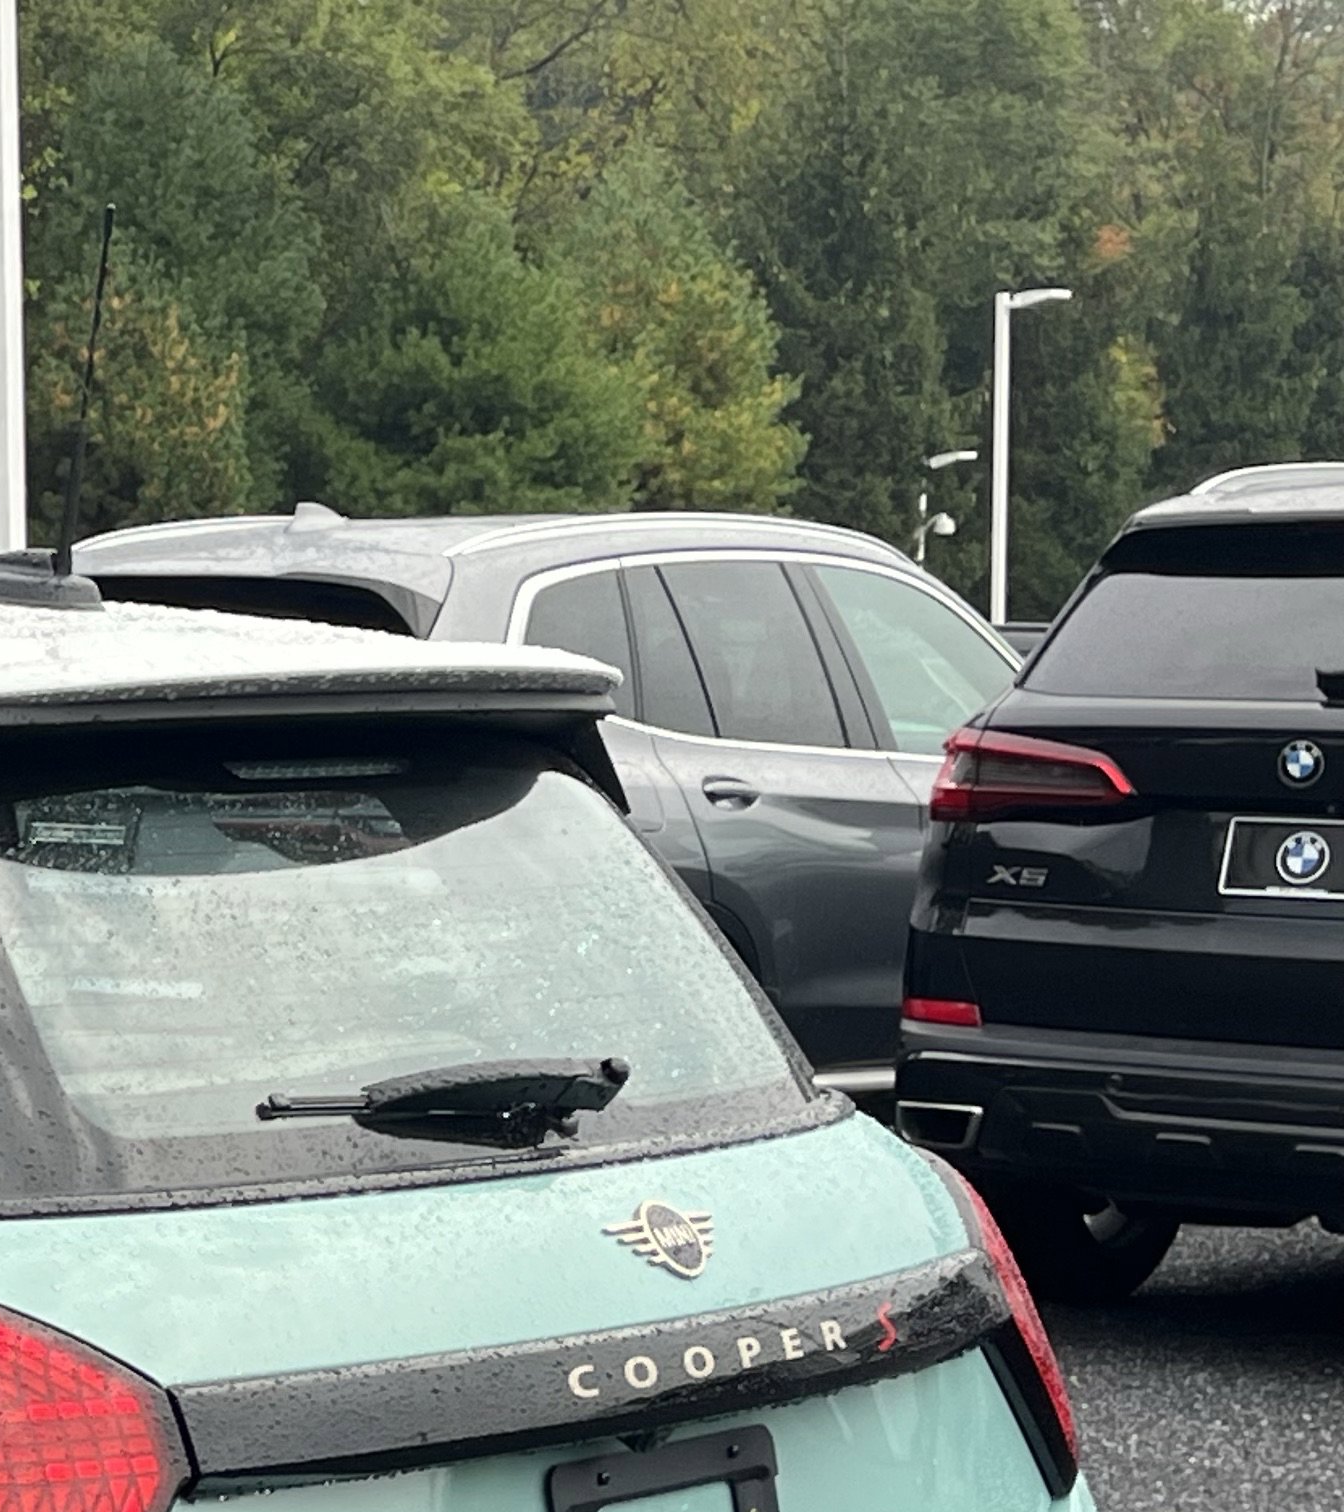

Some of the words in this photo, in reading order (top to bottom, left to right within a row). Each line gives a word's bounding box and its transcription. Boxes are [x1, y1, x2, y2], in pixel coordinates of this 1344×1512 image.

[986, 864, 1049, 887] X5
[653, 1223, 697, 1249] MINI
[567, 1319, 847, 1398] COOPER
[876, 1301, 897, 1352] S
